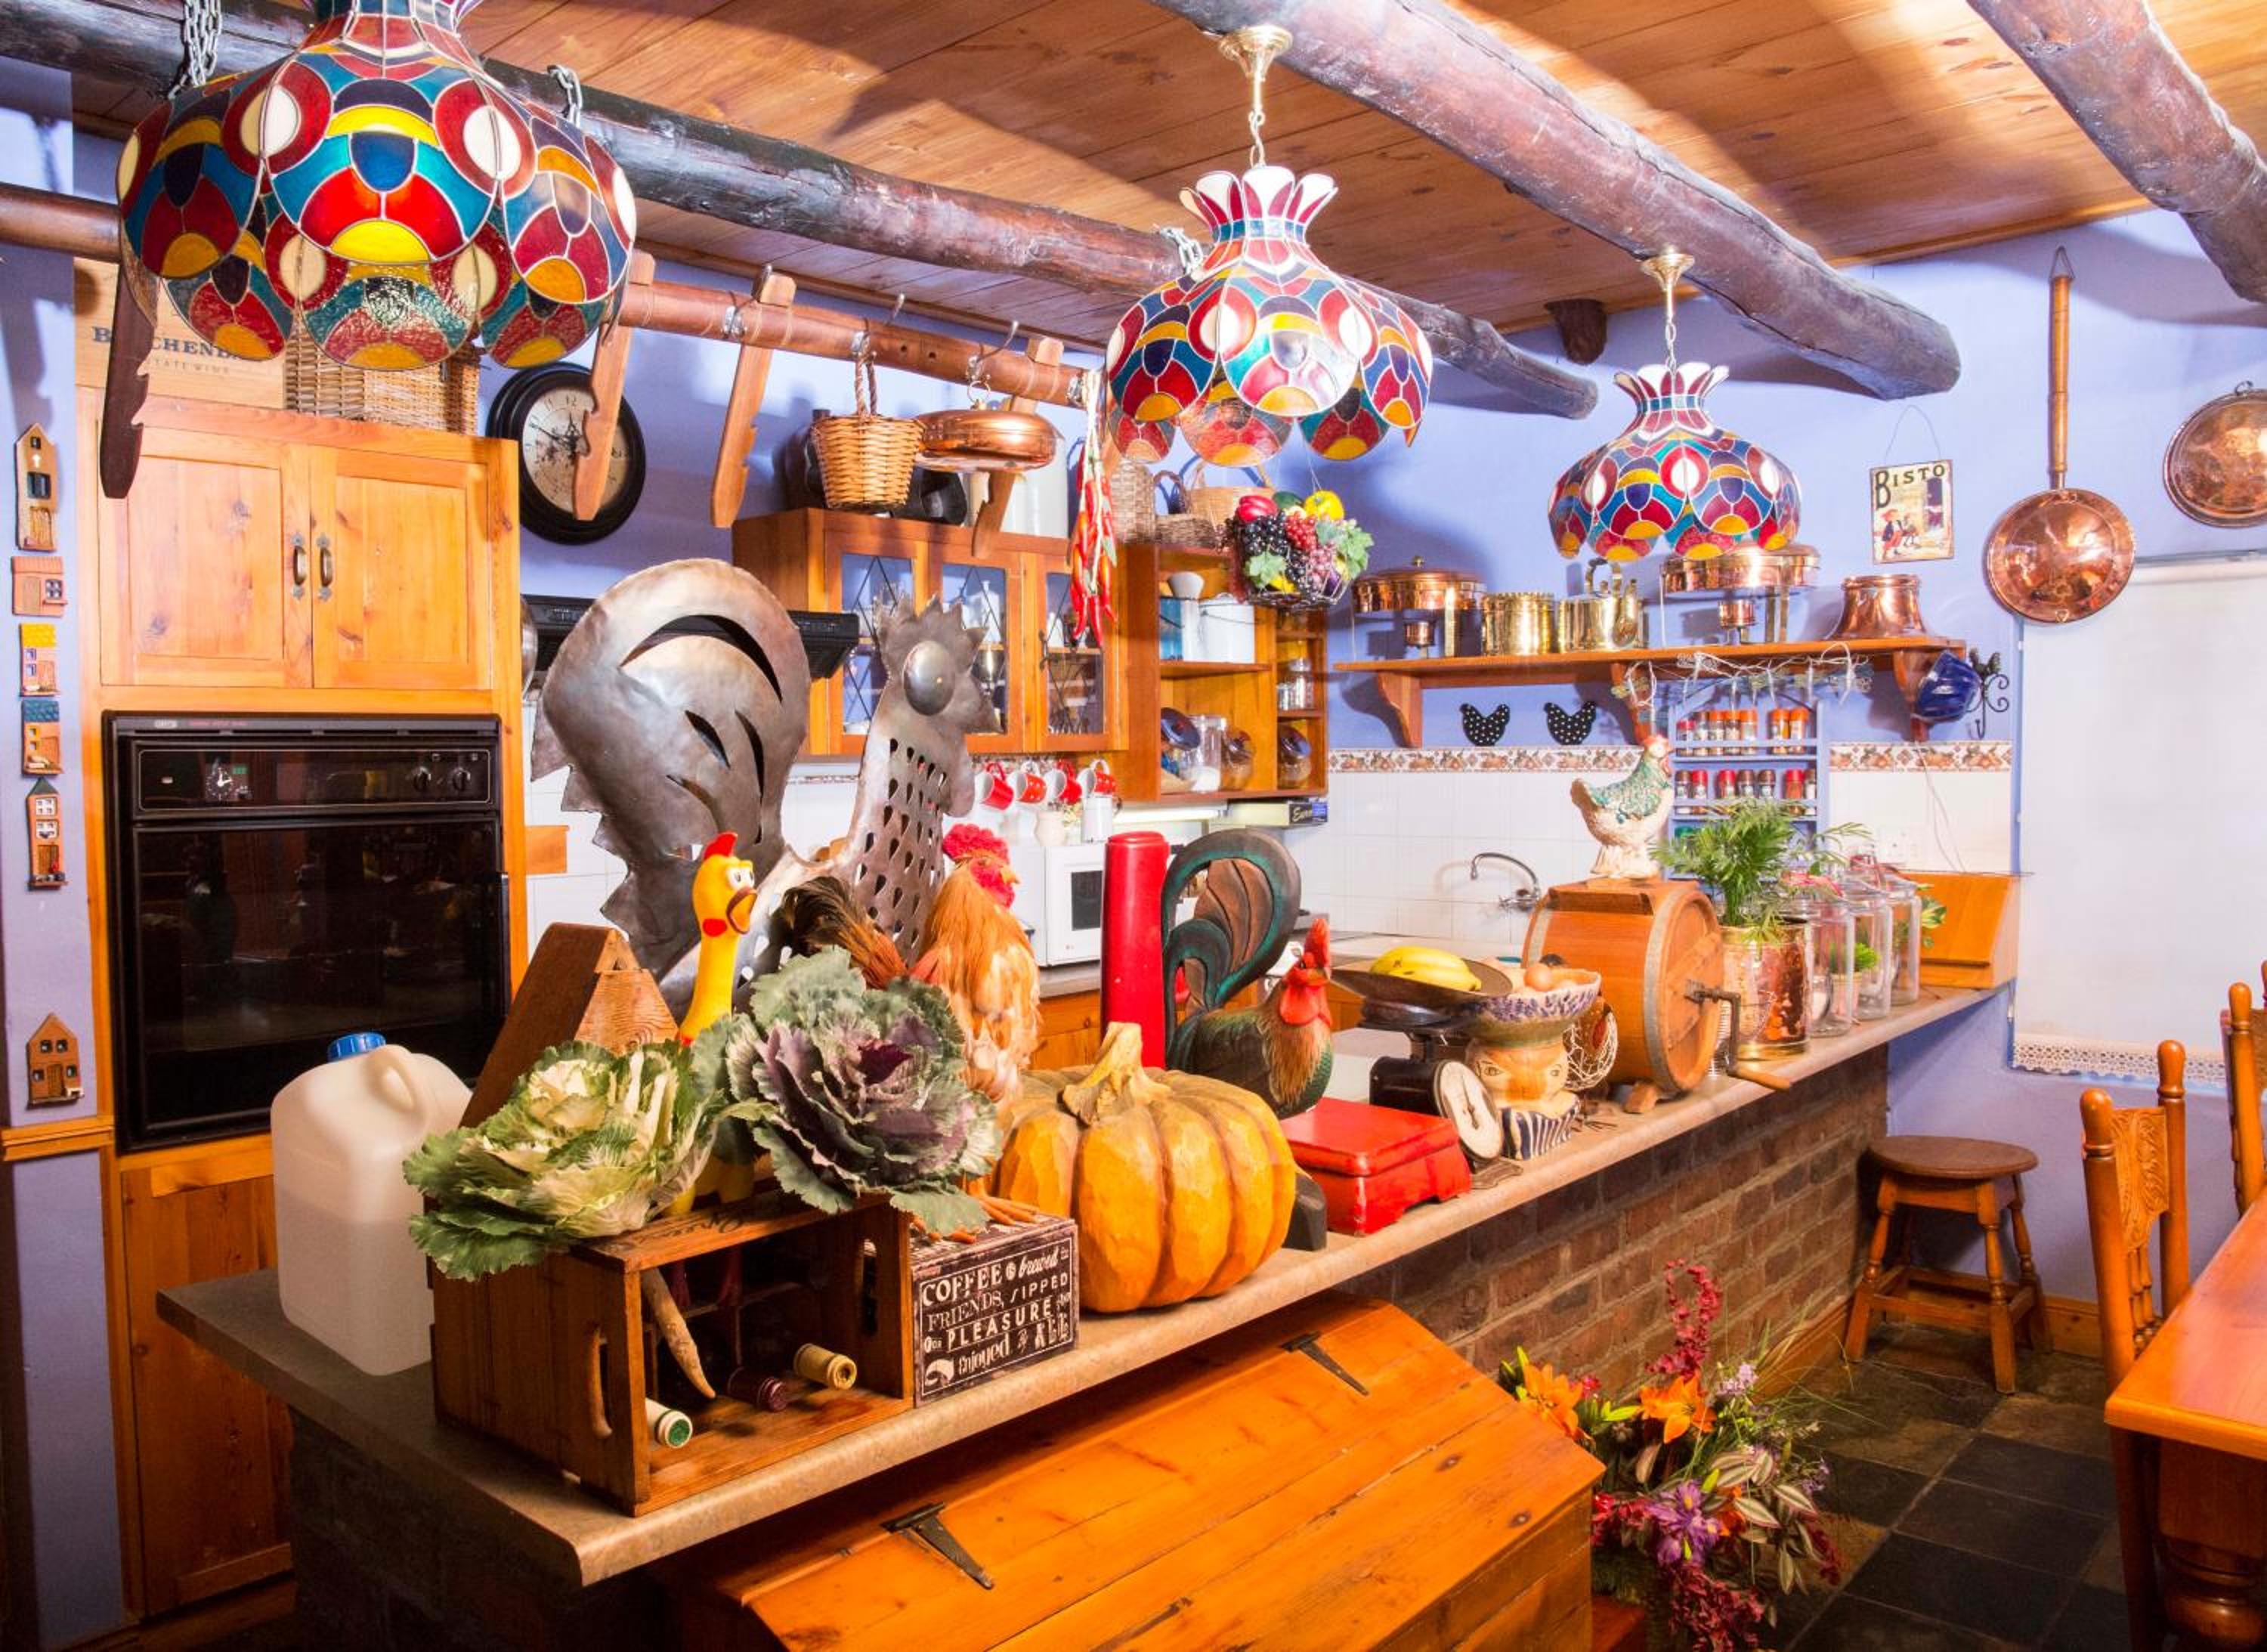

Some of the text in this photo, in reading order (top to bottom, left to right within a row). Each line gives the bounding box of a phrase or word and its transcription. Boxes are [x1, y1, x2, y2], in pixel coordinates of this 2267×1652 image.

[1875, 464, 1946, 509] BISTO
[922, 1263, 1003, 1306] COFFEE
[1018, 1245, 1059, 1279] brewed
[927, 1272, 1068, 1332] FRIENDS, SIPPED
[948, 1300, 1052, 1350] PLEASURE
[1035, 1313, 1069, 1350] ALL
